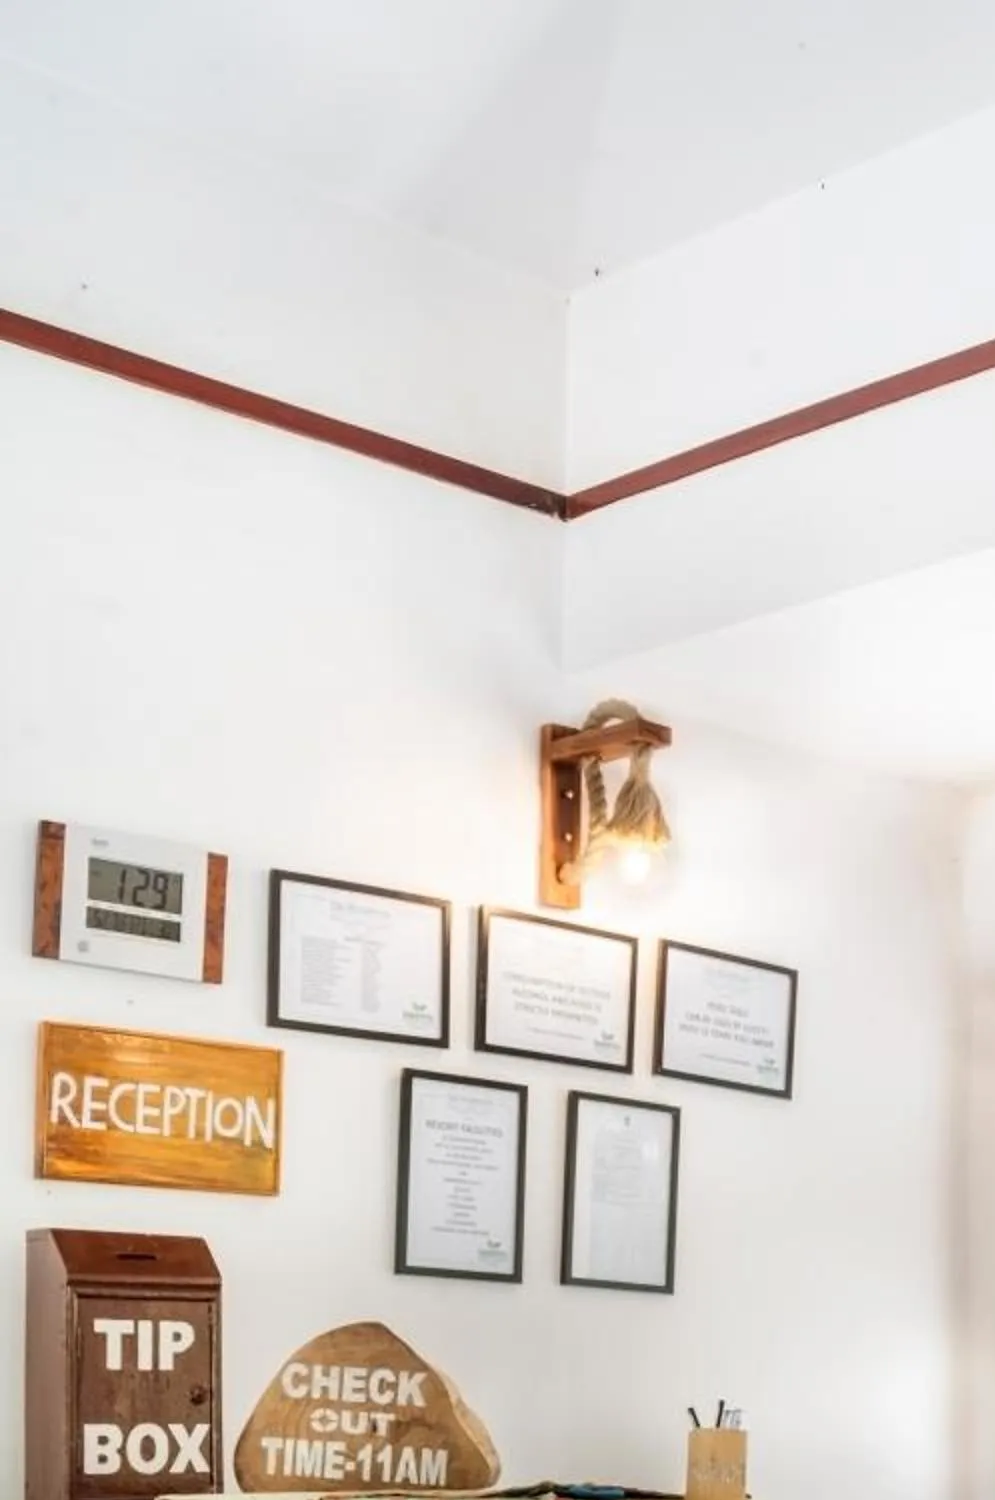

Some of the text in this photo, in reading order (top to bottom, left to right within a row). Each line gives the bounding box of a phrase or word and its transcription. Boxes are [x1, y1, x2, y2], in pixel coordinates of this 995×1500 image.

[51, 1071, 276, 1149] RECEPTION
[93, 1318, 196, 1371] TIP
[281, 1362, 428, 1407] CHECK
[310, 1407, 396, 1437] OUT
[83, 1422, 211, 1475] BOX
[261, 1437, 449, 1487] TIME-11AM
